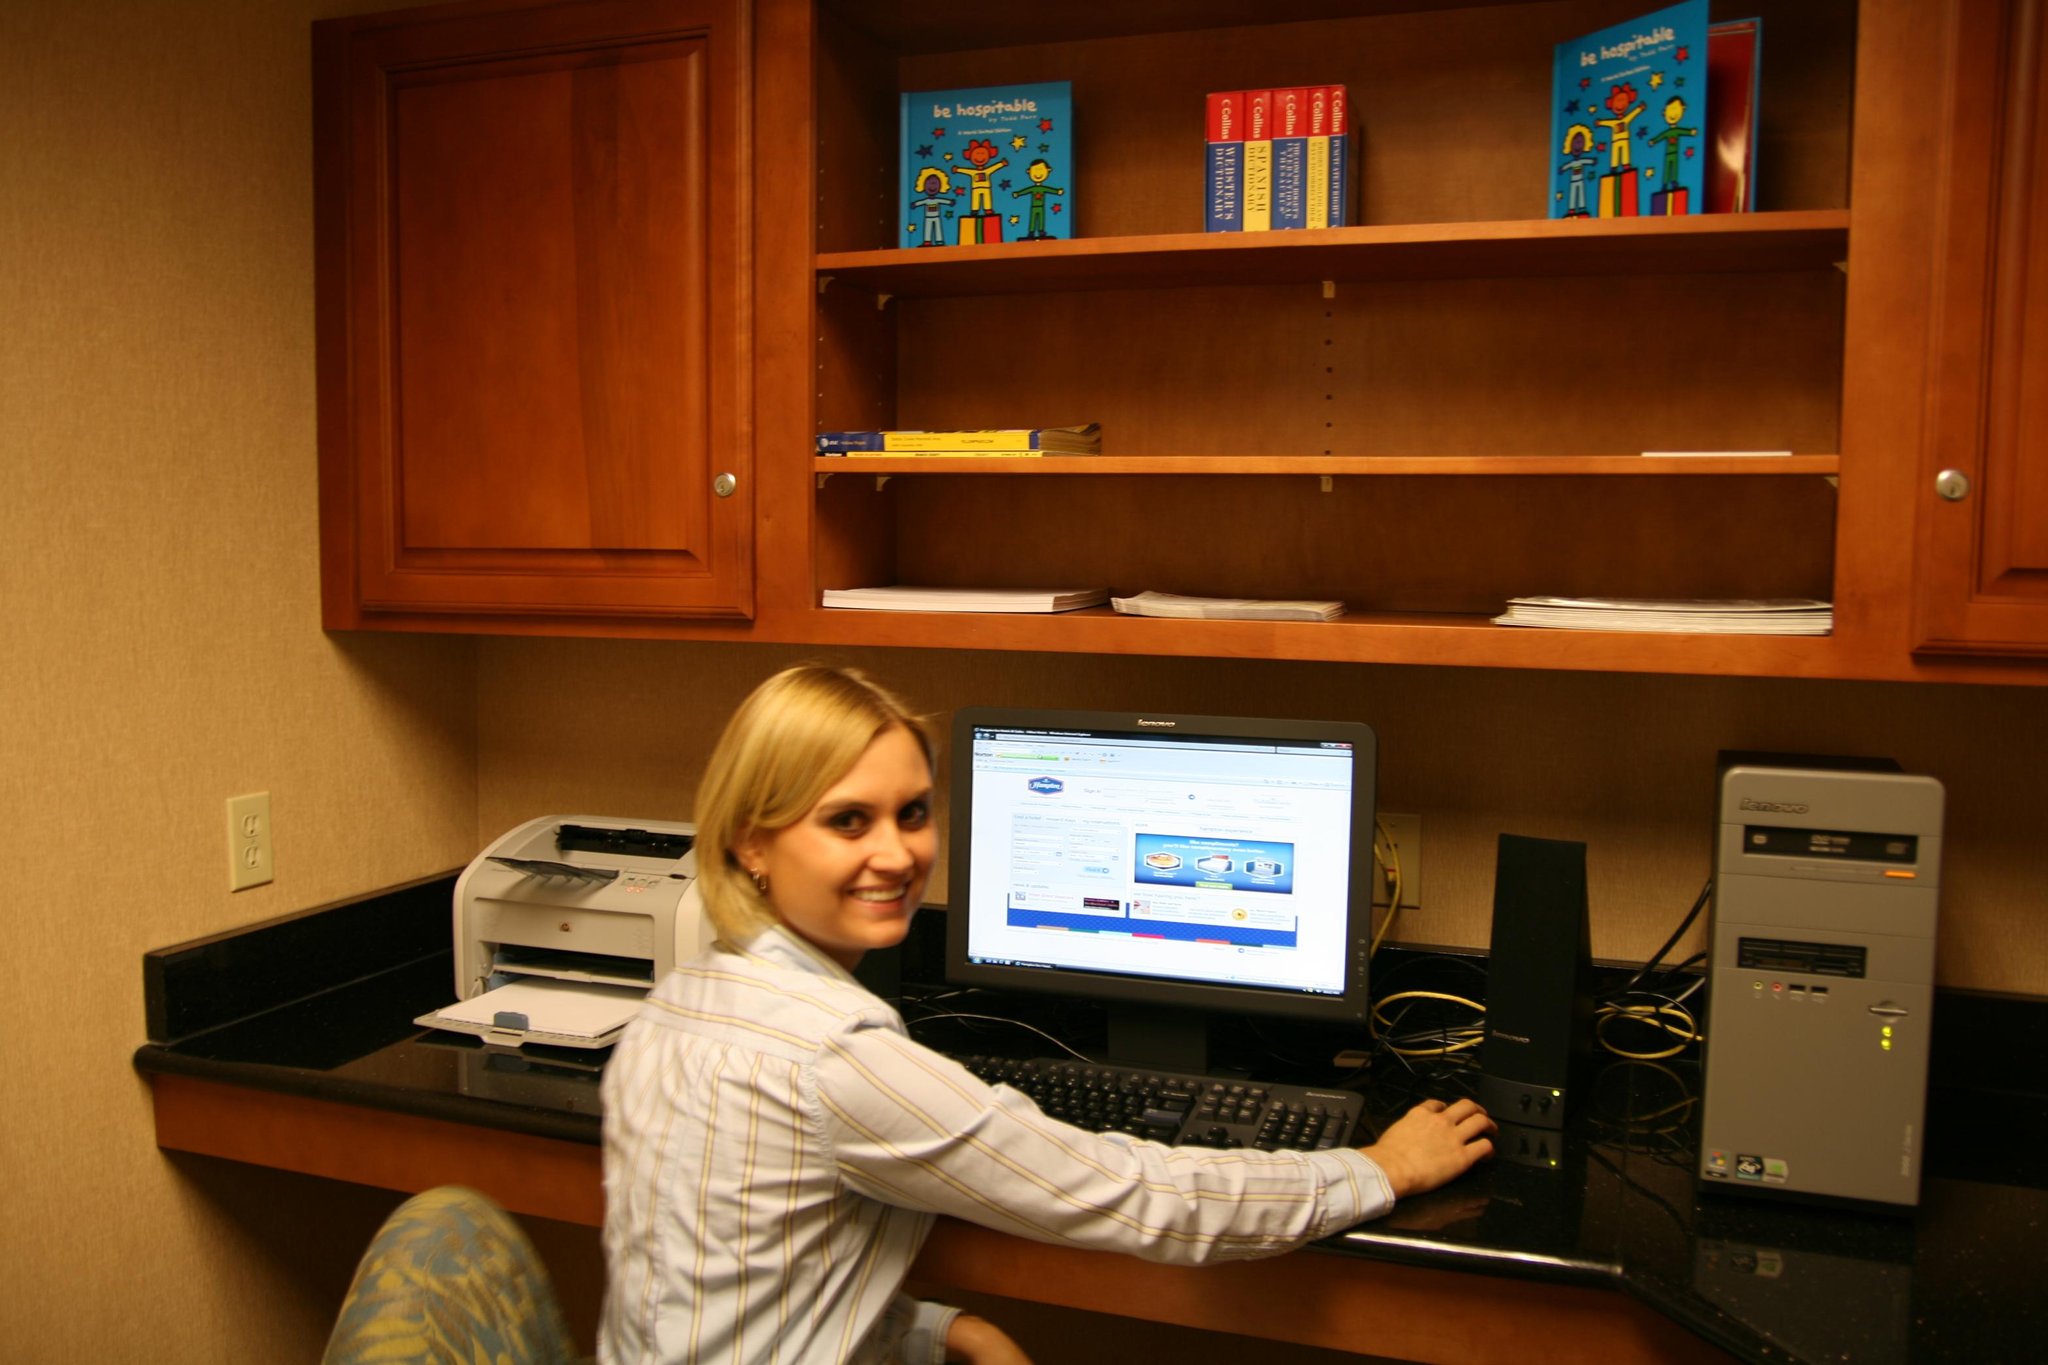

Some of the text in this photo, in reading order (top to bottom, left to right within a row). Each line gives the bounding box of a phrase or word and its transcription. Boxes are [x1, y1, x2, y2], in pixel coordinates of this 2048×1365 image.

[1580, 51, 1598, 67] be
[1600, 26, 1675, 59] hospitable
[933, 98, 1037, 119] be hospitable
[1222, 108, 1232, 139] Collins
[1253, 106, 1264, 138] Collins
[1286, 103, 1297, 135] Collins
[1312, 101, 1324, 134] Collins
[1332, 100, 1343, 132] Collins
[1215, 148, 1225, 219] DICTIONARY
[1224, 147, 1236, 220] WEBSTER'S
[1248, 147, 1256, 211] DICTIONARY
[1256, 146, 1267, 211] SPANISH
[1284, 143, 1294, 219] INTERNATIONAL
[1137, 719, 1176, 728] lenovo
[1031, 781, 1062, 791] Hampton
[1739, 798, 1810, 815] lenovo
